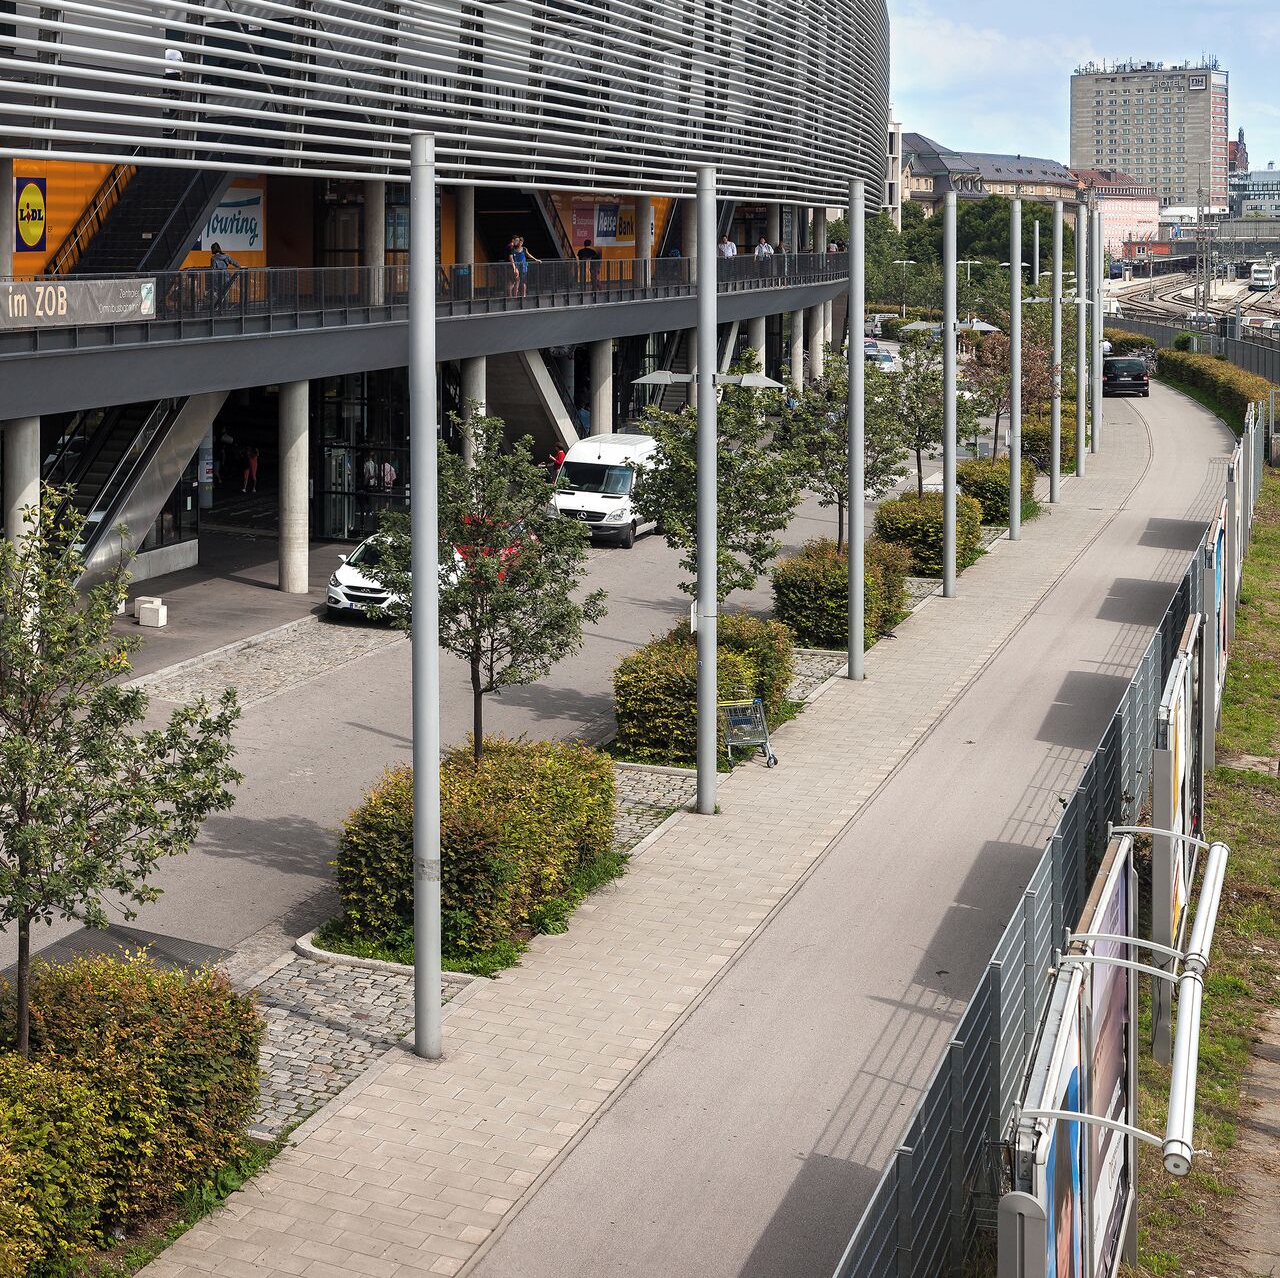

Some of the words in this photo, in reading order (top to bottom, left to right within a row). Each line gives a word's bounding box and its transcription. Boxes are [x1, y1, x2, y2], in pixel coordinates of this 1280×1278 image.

[1153, 80, 1185, 88] HOTEL
[8, 285, 28, 318] im
[35, 285, 68, 317] ZOB
